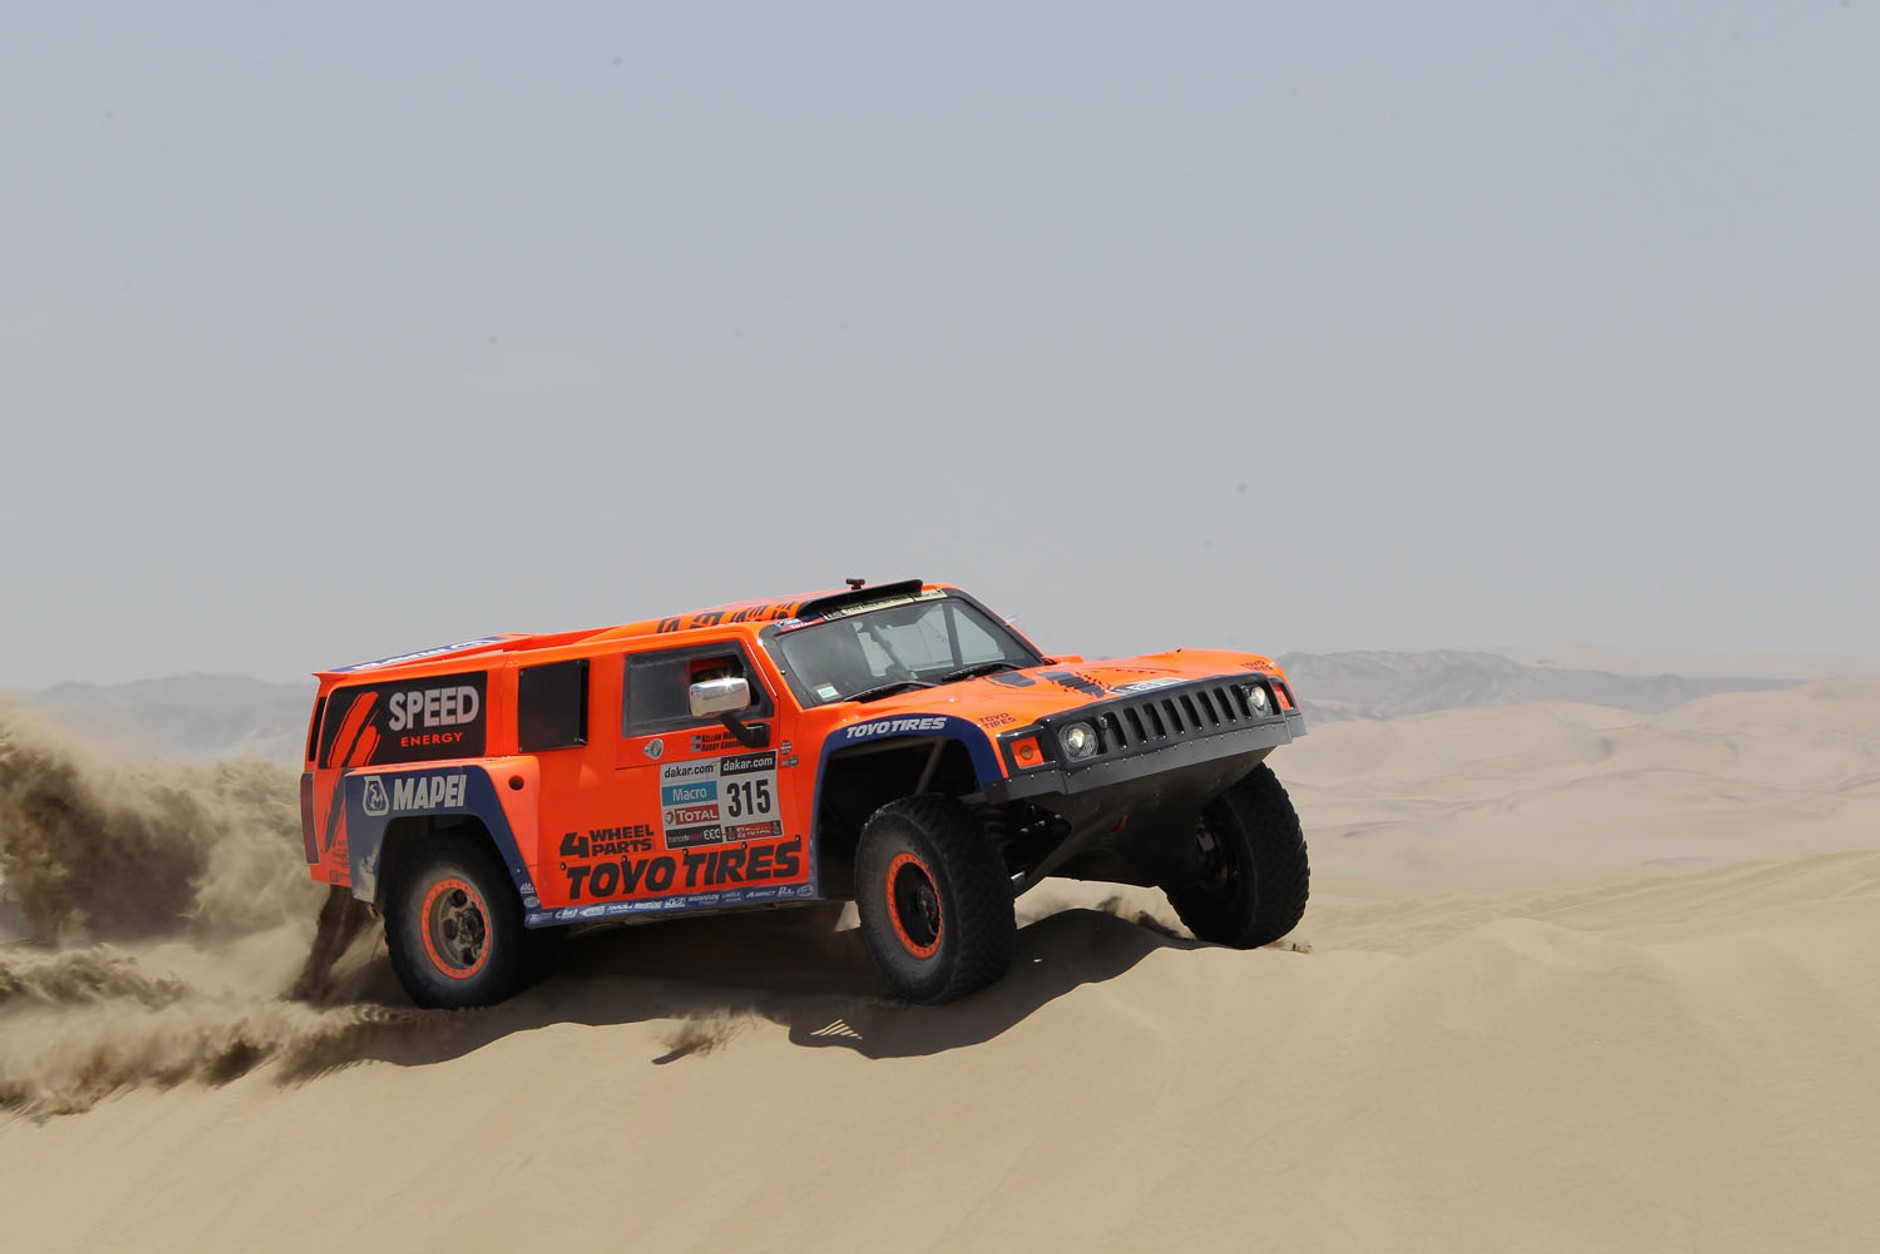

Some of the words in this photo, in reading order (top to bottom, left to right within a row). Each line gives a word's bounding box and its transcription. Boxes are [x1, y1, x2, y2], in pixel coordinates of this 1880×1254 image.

[389, 686, 479, 731] SPEED
[846, 722, 887, 739] TOYO
[889, 717, 947, 732] TIRES
[401, 732, 463, 747] ENERGY
[664, 764, 714, 778] dakar.com
[723, 757, 773, 771] dakar.com
[393, 775, 467, 811] MAPEI
[672, 788, 707, 801] Macro
[726, 779, 771, 818] 315
[559, 832, 588, 858] 4
[588, 824, 654, 842] WHEEL
[592, 839, 653, 856] PARTS
[566, 856, 676, 899] TOYO
[683, 841, 802, 887] TIRES
